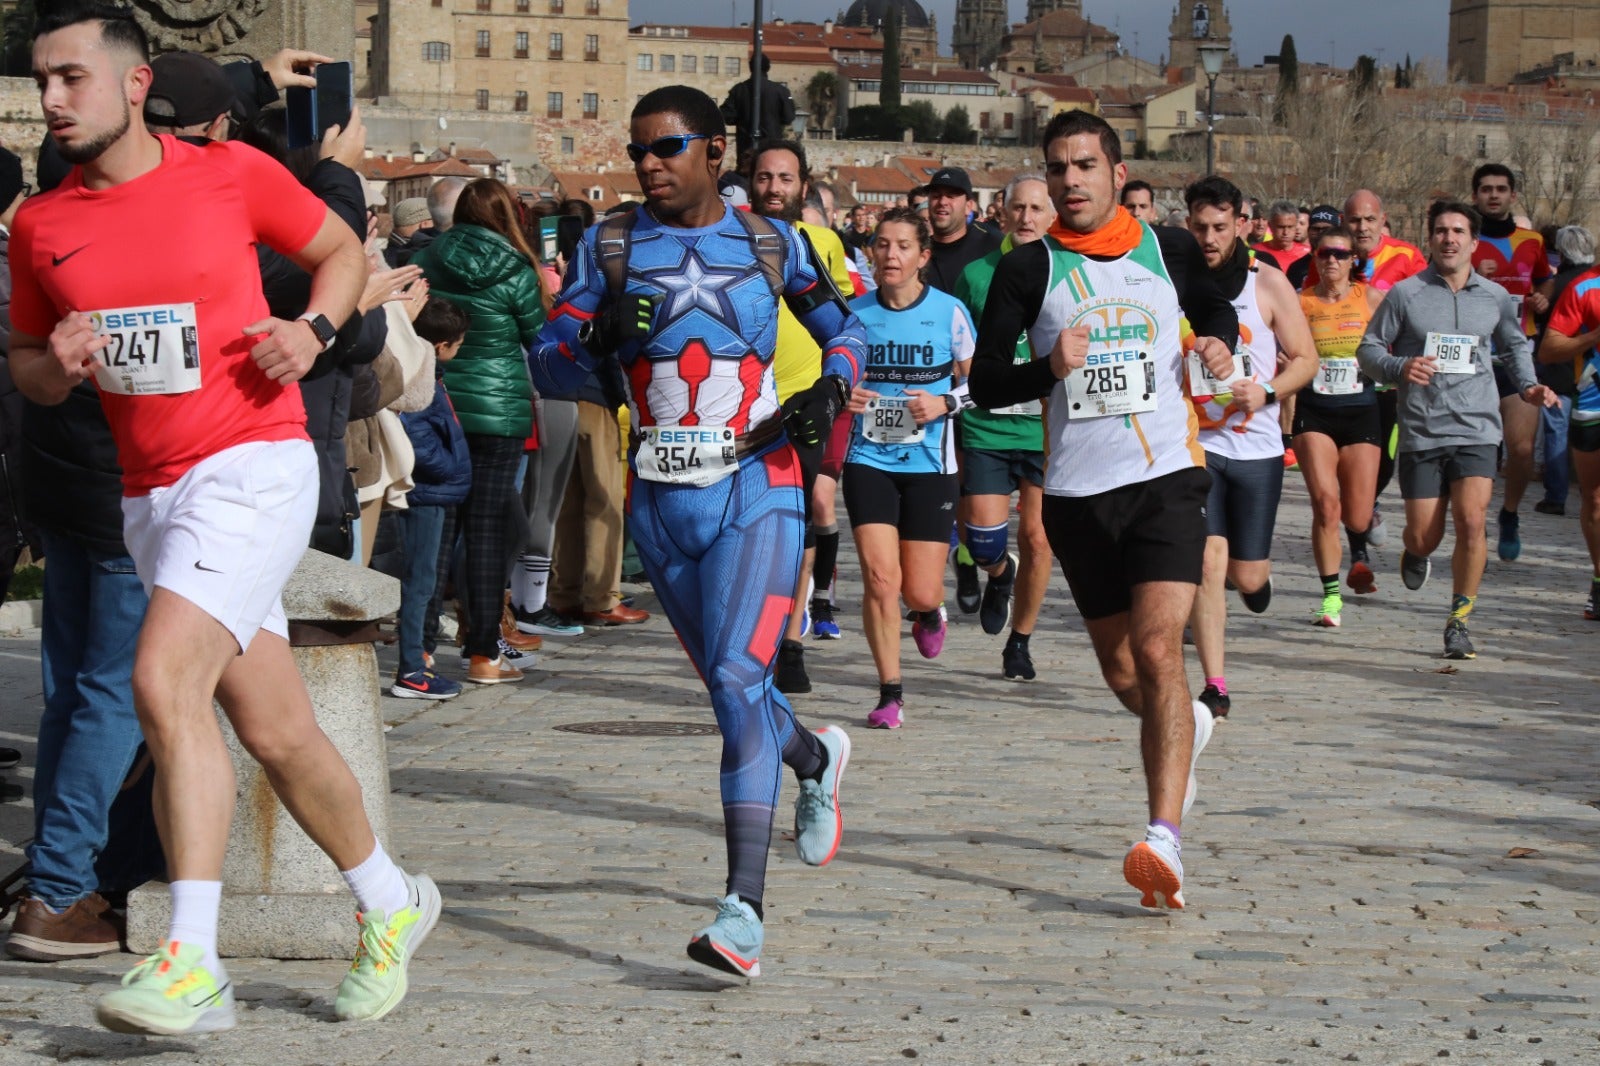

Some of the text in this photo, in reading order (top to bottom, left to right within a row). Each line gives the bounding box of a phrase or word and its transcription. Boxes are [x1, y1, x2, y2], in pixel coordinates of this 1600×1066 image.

[105, 309, 183, 329] SETEL
[1066, 297, 1157, 323] CLUB DEPORTIVO
[100, 330, 160, 367] 1247
[1441, 336, 1473, 344] SETEL
[1437, 344, 1461, 361] 1918
[888, 370, 902, 380] de
[1083, 365, 1128, 394] 285
[1325, 368, 1347, 382] 877
[875, 409, 904, 428] 862
[660, 430, 725, 444] SETEL
[655, 446, 704, 474] 354
